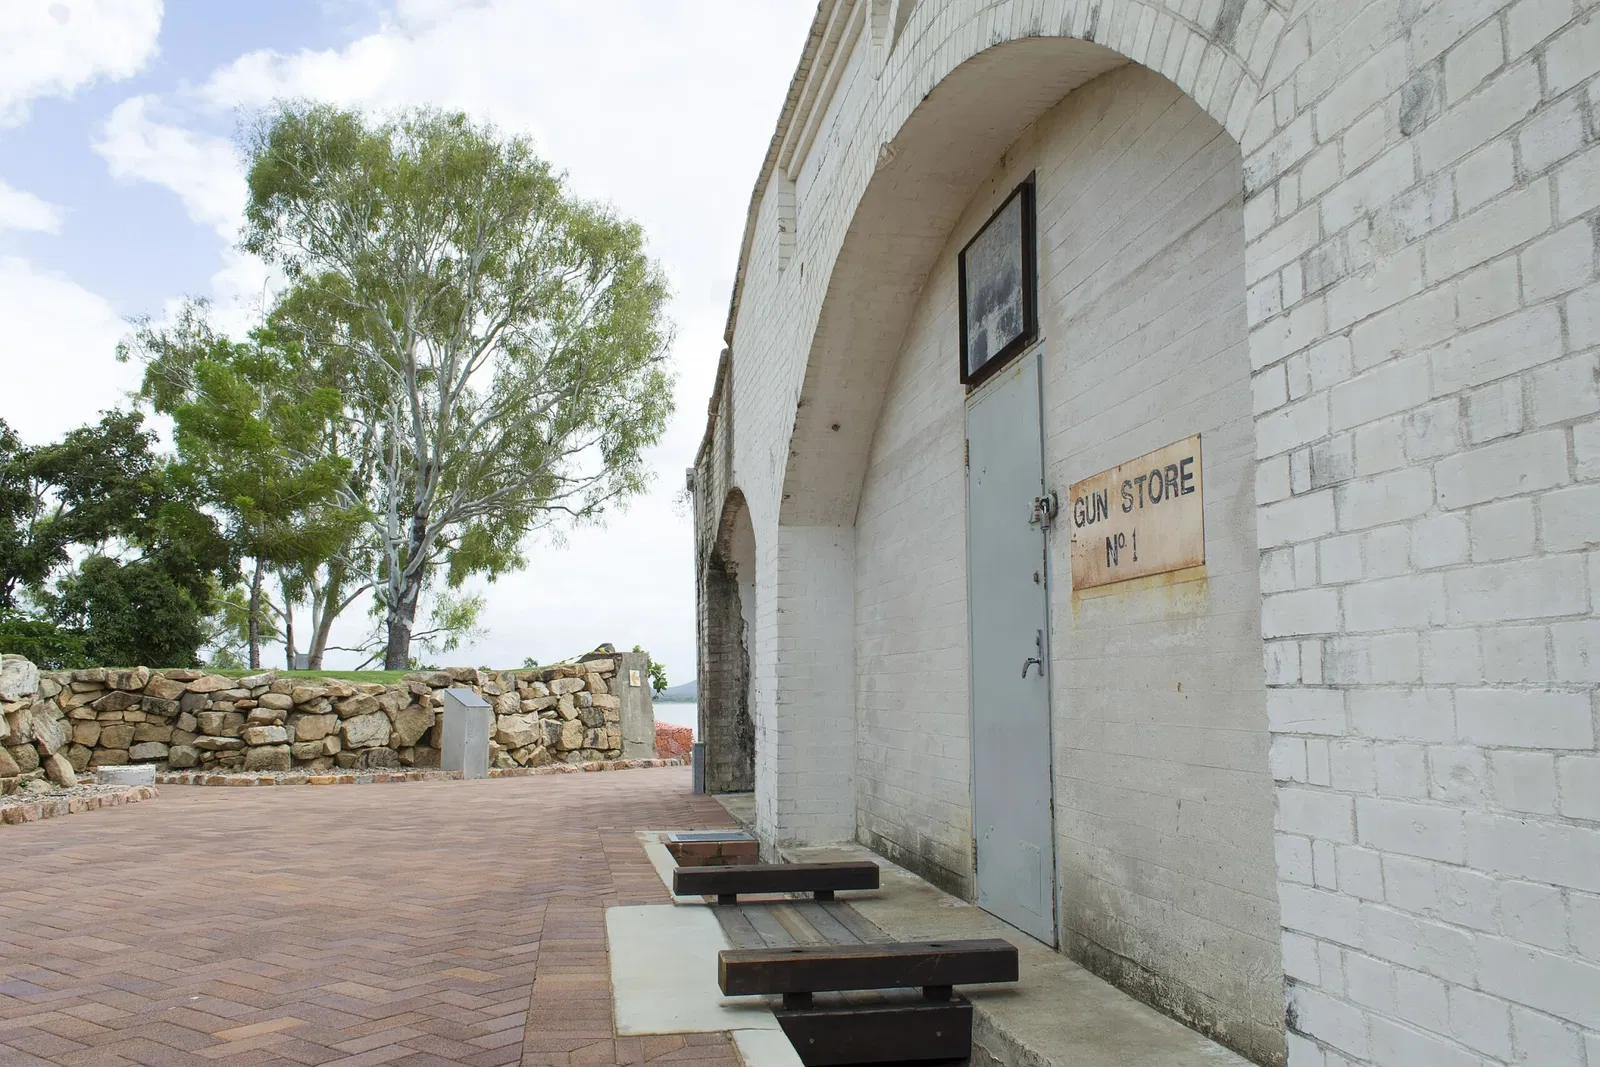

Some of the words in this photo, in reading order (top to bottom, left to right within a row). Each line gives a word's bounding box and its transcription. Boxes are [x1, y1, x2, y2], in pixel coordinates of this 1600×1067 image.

[1073, 488, 1108, 528] GUN
[1121, 456, 1195, 513] STORE
[1132, 527, 1138, 562] 1
